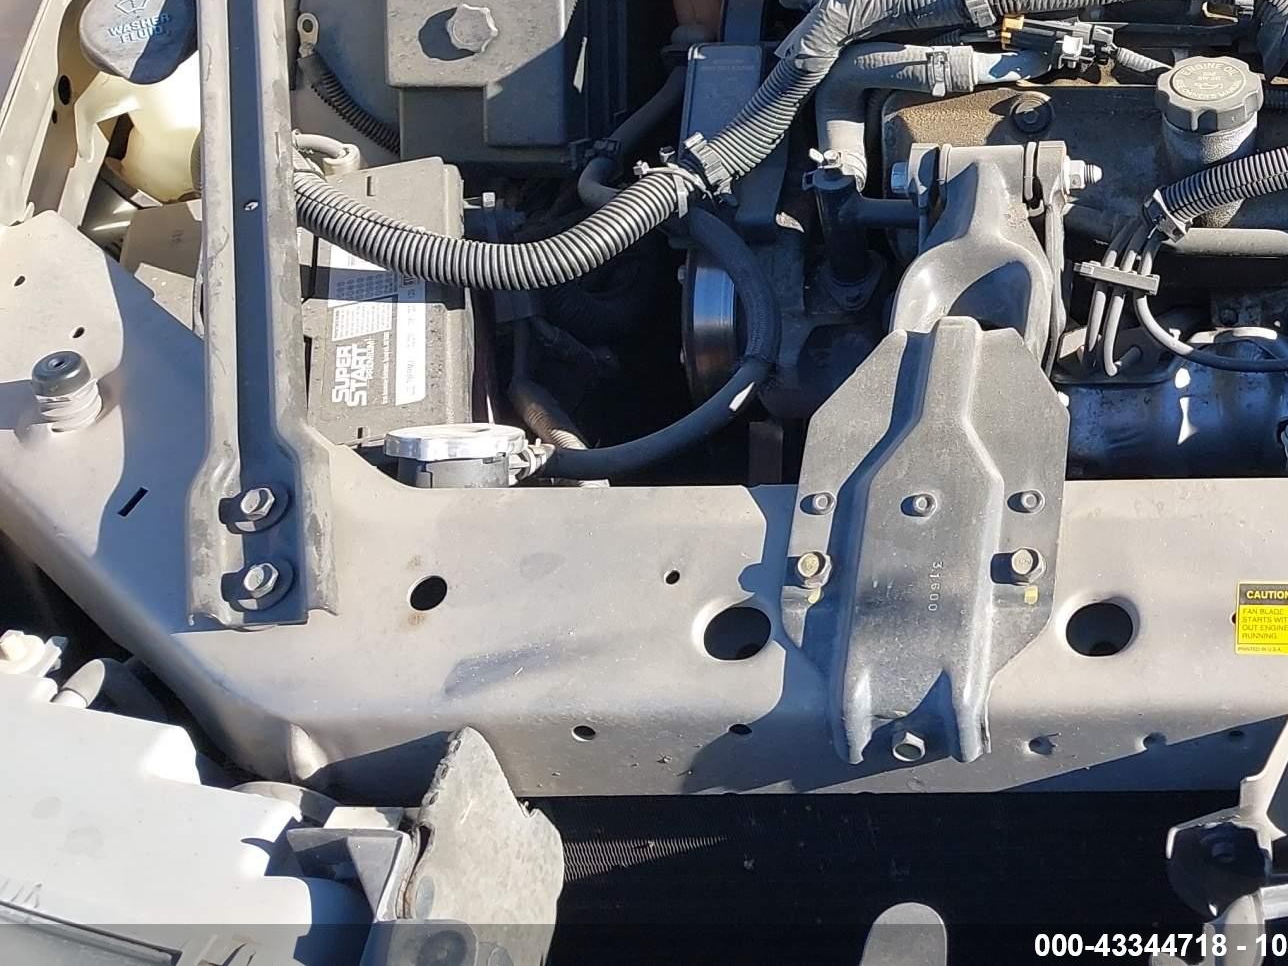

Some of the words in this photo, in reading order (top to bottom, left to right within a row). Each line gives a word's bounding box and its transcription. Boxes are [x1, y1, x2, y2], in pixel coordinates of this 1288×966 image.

[107, 14, 170, 36] WASHER
[1181, 63, 1222, 76] ENGINE
[332, 345, 351, 403] SUPER
[347, 343, 368, 407] START
[928, 561, 942, 611] 31600
[1259, 608, 1285, 616] BLADE
